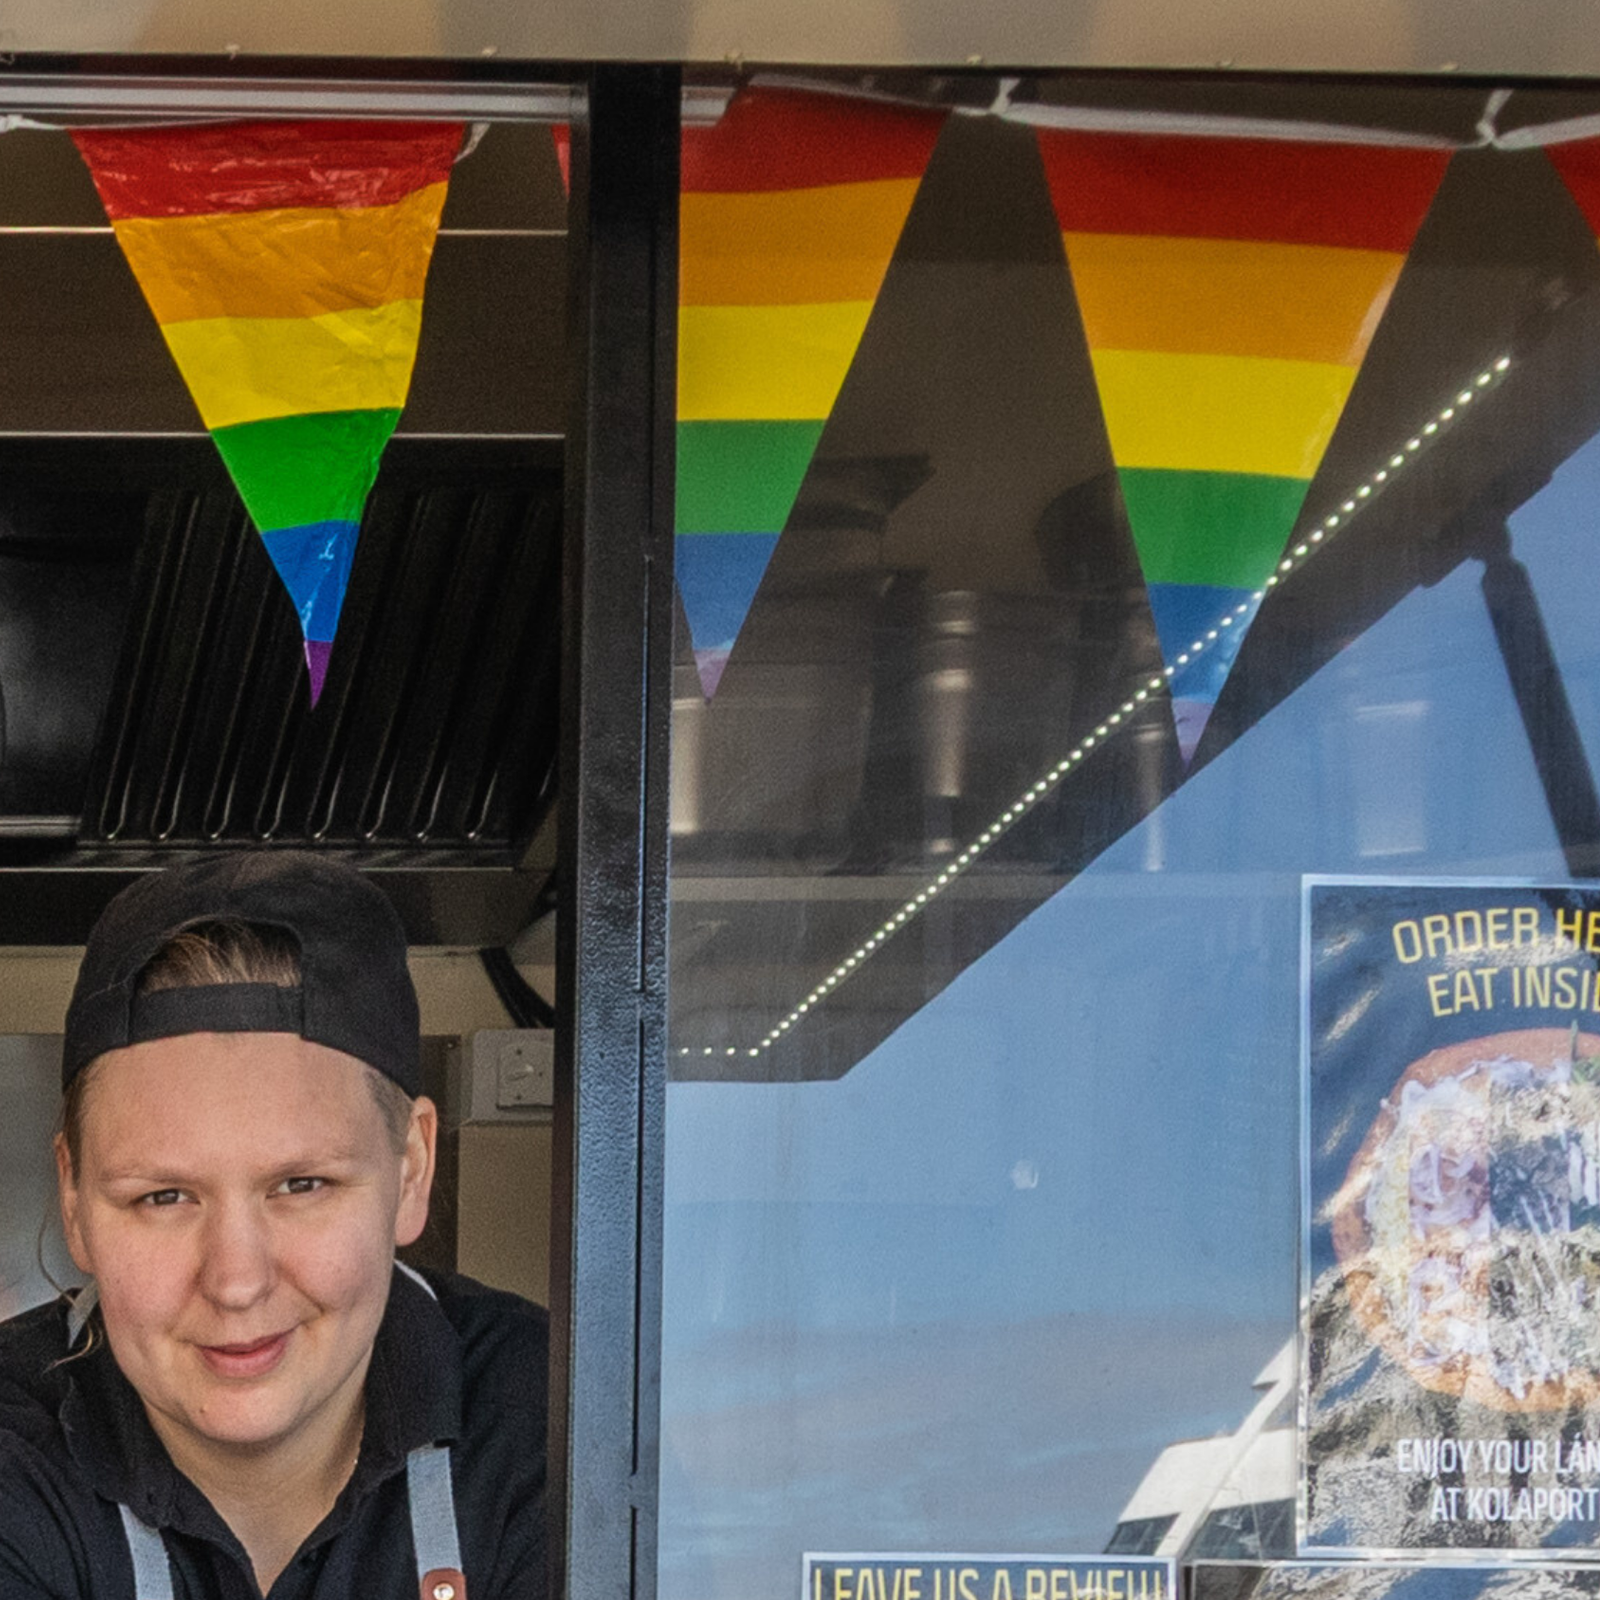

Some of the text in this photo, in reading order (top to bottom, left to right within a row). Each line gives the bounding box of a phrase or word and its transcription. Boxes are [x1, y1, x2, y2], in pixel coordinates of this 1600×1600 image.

[1391, 906, 1539, 964] ORDER
[1427, 966, 1600, 1017] EAT INSI
[1397, 1438, 1472, 1479] ENJOY
[1479, 1440, 1548, 1473] YOUR
[1430, 1487, 1462, 1521] AT
